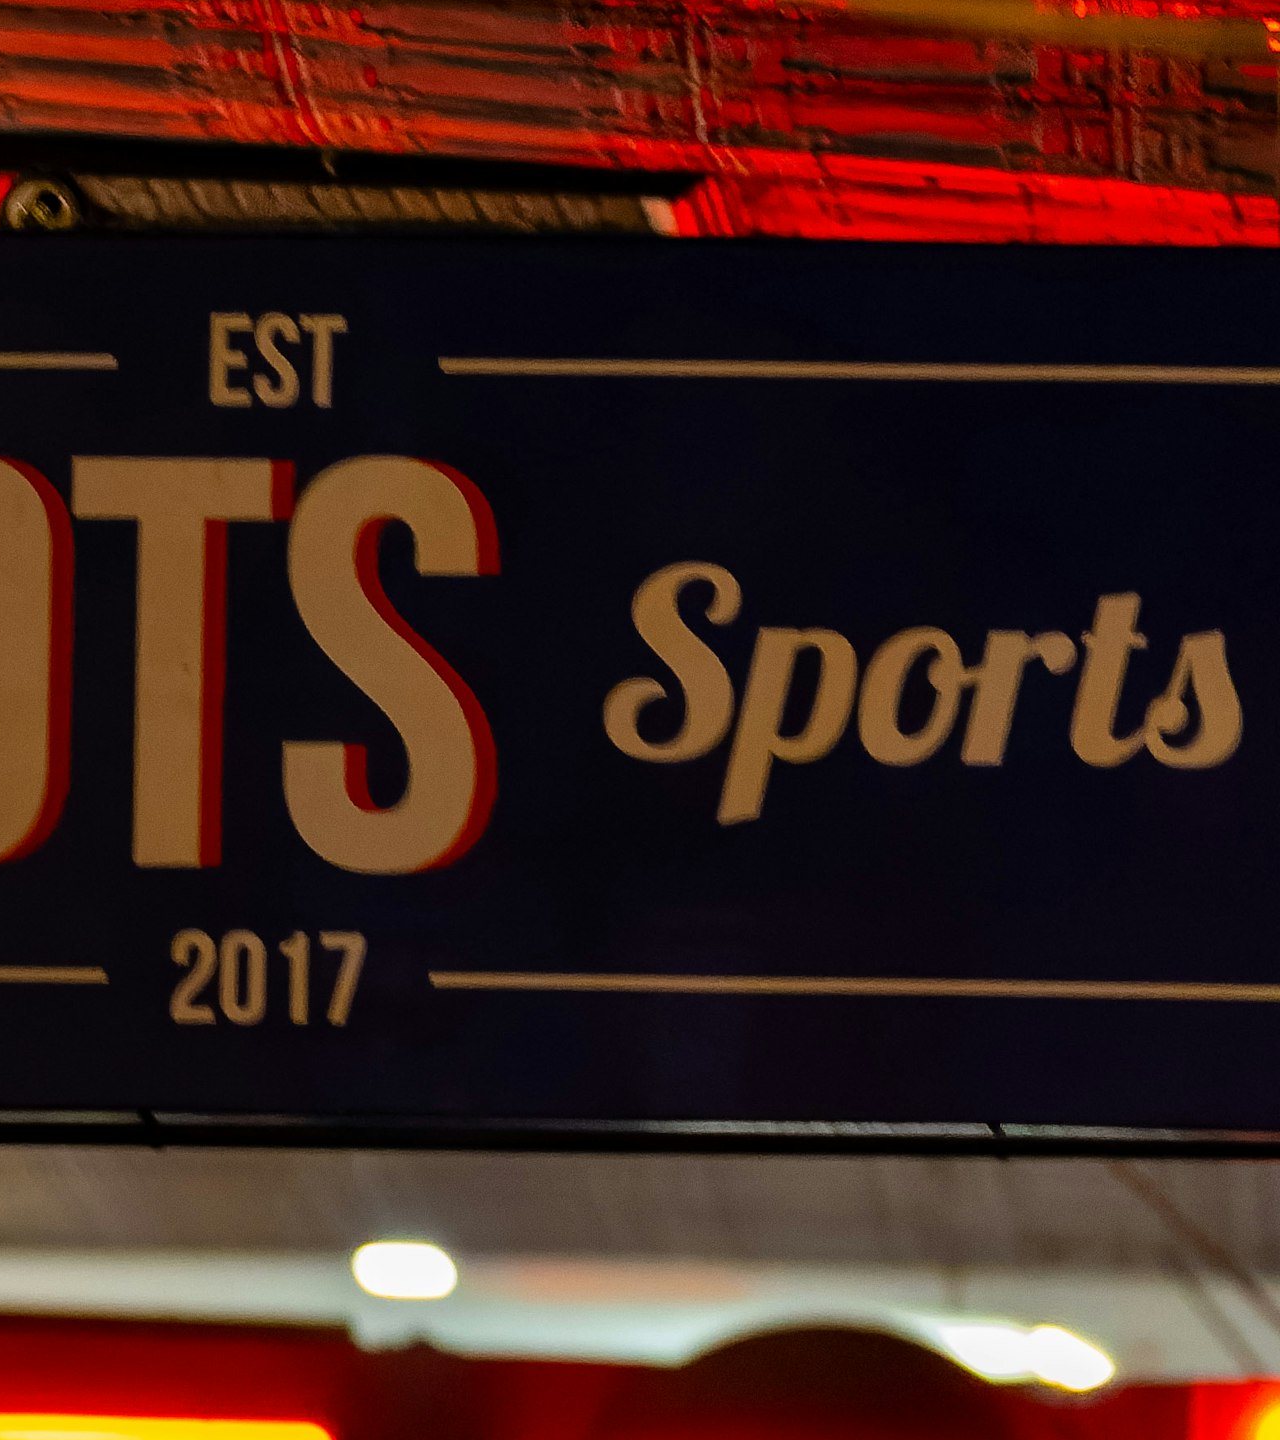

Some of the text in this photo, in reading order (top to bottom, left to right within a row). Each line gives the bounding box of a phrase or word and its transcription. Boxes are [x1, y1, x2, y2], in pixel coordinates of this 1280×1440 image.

[207, 310, 348, 409] EST
[602, 561, 1244, 826] Sports
[169, 929, 368, 1027] 2017
